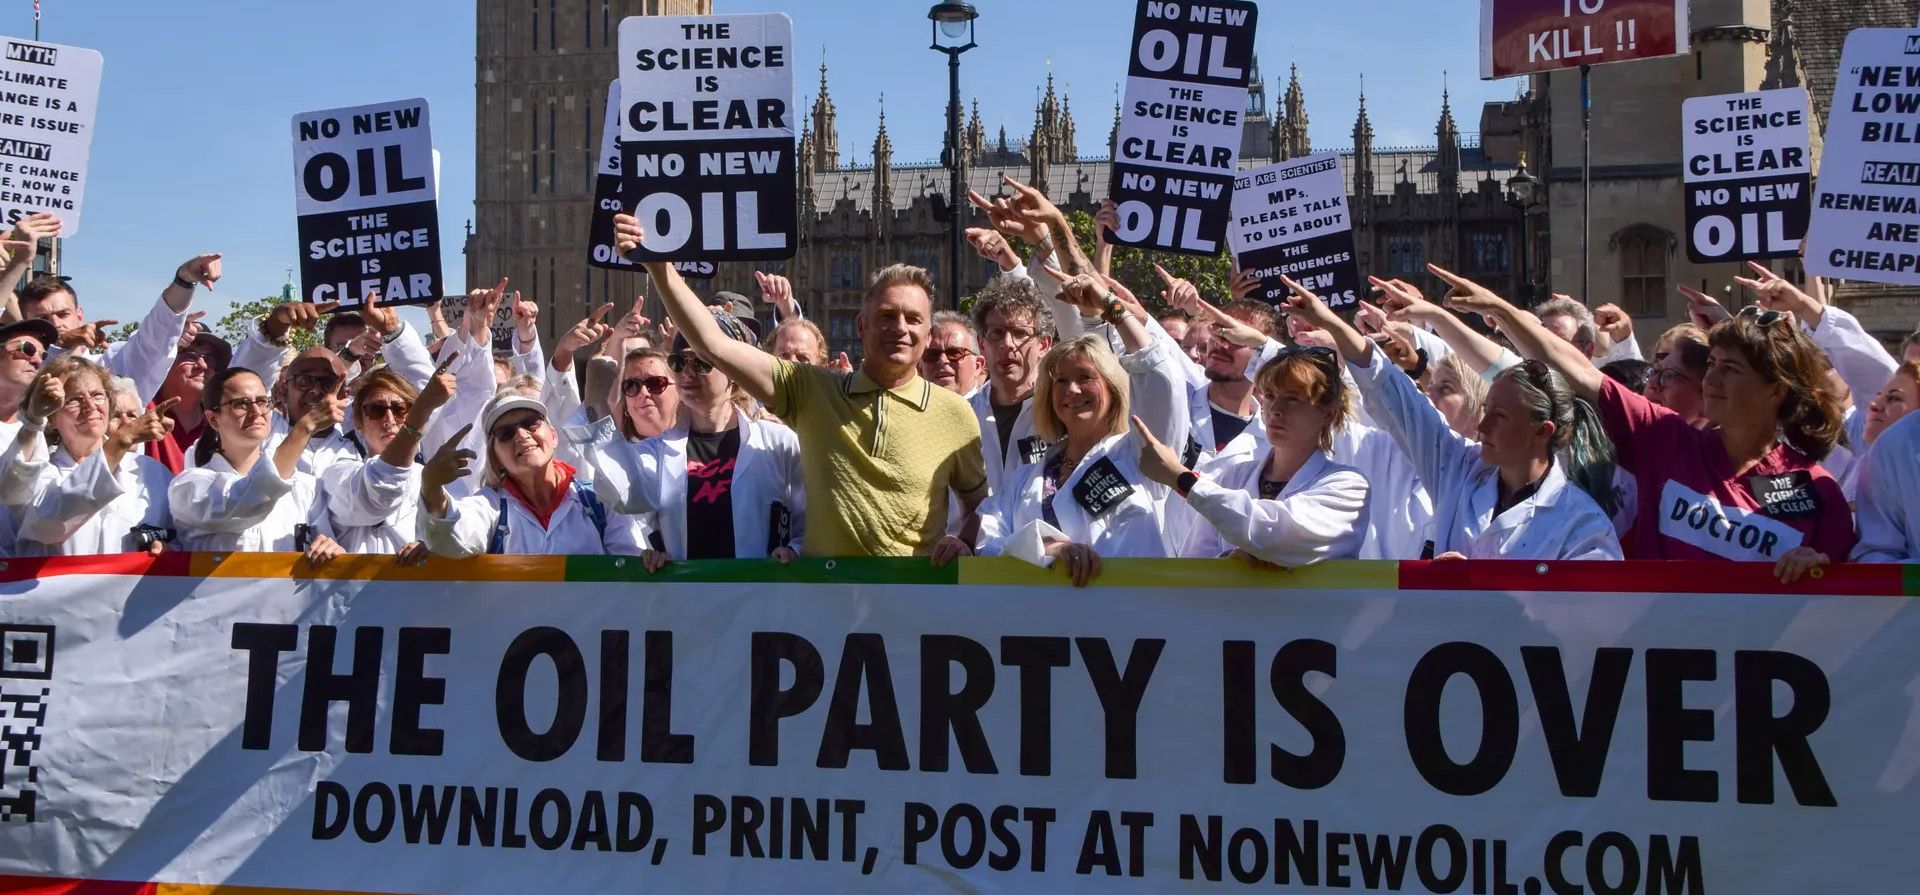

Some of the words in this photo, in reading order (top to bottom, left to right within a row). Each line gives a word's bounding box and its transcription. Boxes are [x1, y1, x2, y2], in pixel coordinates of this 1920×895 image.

[1146, 1, 1181, 21] NO
[1190, 5, 1248, 27] NEW
[681, 23, 730, 40] THE
[1528, 25, 1604, 63] KILL
[1616, 18, 1635, 51] !!
[7, 43, 57, 66] MYTH
[636, 45, 784, 71] SCIENCE
[1138, 29, 1243, 80] OIL
[695, 75, 719, 92] IS
[1169, 87, 1203, 102] THE
[45, 98, 61, 110] IS
[67, 101, 77, 112] A
[628, 98, 787, 133] CLEAR
[1134, 101, 1237, 126] SCIENCE
[1726, 97, 1762, 112] THE
[300, 118, 340, 141] NO
[353, 107, 421, 135] NEW
[1172, 125, 1189, 138] IS
[1694, 110, 1802, 135] SCIENCE
[1737, 134, 1754, 146] IS
[636, 153, 685, 178] NO
[699, 150, 781, 177] NEW
[1122, 137, 1232, 169] CLEAR
[1689, 146, 1803, 176] CLEAR
[20, 165, 79, 182] CHANGE
[303, 144, 426, 202] OIL
[1234, 178, 1251, 190] WE
[1256, 172, 1276, 186] ARE
[1281, 158, 1336, 181] SCIENTISTS
[22, 180, 55, 192] NOW
[62, 185, 71, 195] &
[1121, 172, 1156, 192] NO
[1165, 177, 1224, 200] NEW
[1695, 188, 1730, 207] NO
[1740, 182, 1800, 203] NEW
[1, 191, 73, 210] ERATING
[1240, 206, 1298, 227] PLEASE
[1304, 196, 1342, 213] TALK
[348, 213, 389, 231] THE
[634, 190, 786, 253] OIL
[1114, 200, 1216, 252] OIL
[1243, 231, 1263, 243] TO
[1269, 226, 1287, 238] US
[1293, 214, 1342, 233] ABOUT
[1693, 211, 1802, 257] OIL
[1866, 222, 1919, 243] ARE
[310, 228, 429, 260] SCIENCE
[1282, 244, 1309, 257] THE
[361, 259, 381, 274] IS
[312, 273, 432, 306] CLEAR
[1267, 289, 1281, 299] OF
[1030, 440, 1047, 453] NO
[1084, 467, 1103, 487] THE
[1084, 473, 1118, 503] SCIENCE
[1770, 477, 1792, 490] THE
[1090, 500, 1102, 513] IS
[1100, 482, 1128, 503] CLEAR
[1764, 488, 1808, 504] SCIENCE
[1767, 503, 1780, 514] IS
[1780, 498, 1816, 513] CLEAR
[1670, 496, 1778, 557] DOCTOR
[231, 622, 451, 757] THE
[495, 626, 695, 764] OIL
[749, 631, 1167, 780] PARTY
[1222, 638, 1347, 790] IS
[1403, 641, 1839, 808] OVER
[311, 781, 669, 866] DOWNLOAD,
[692, 794, 879, 876] PRINT,
[903, 801, 1056, 873] POST
[1075, 809, 1154, 878] AT
